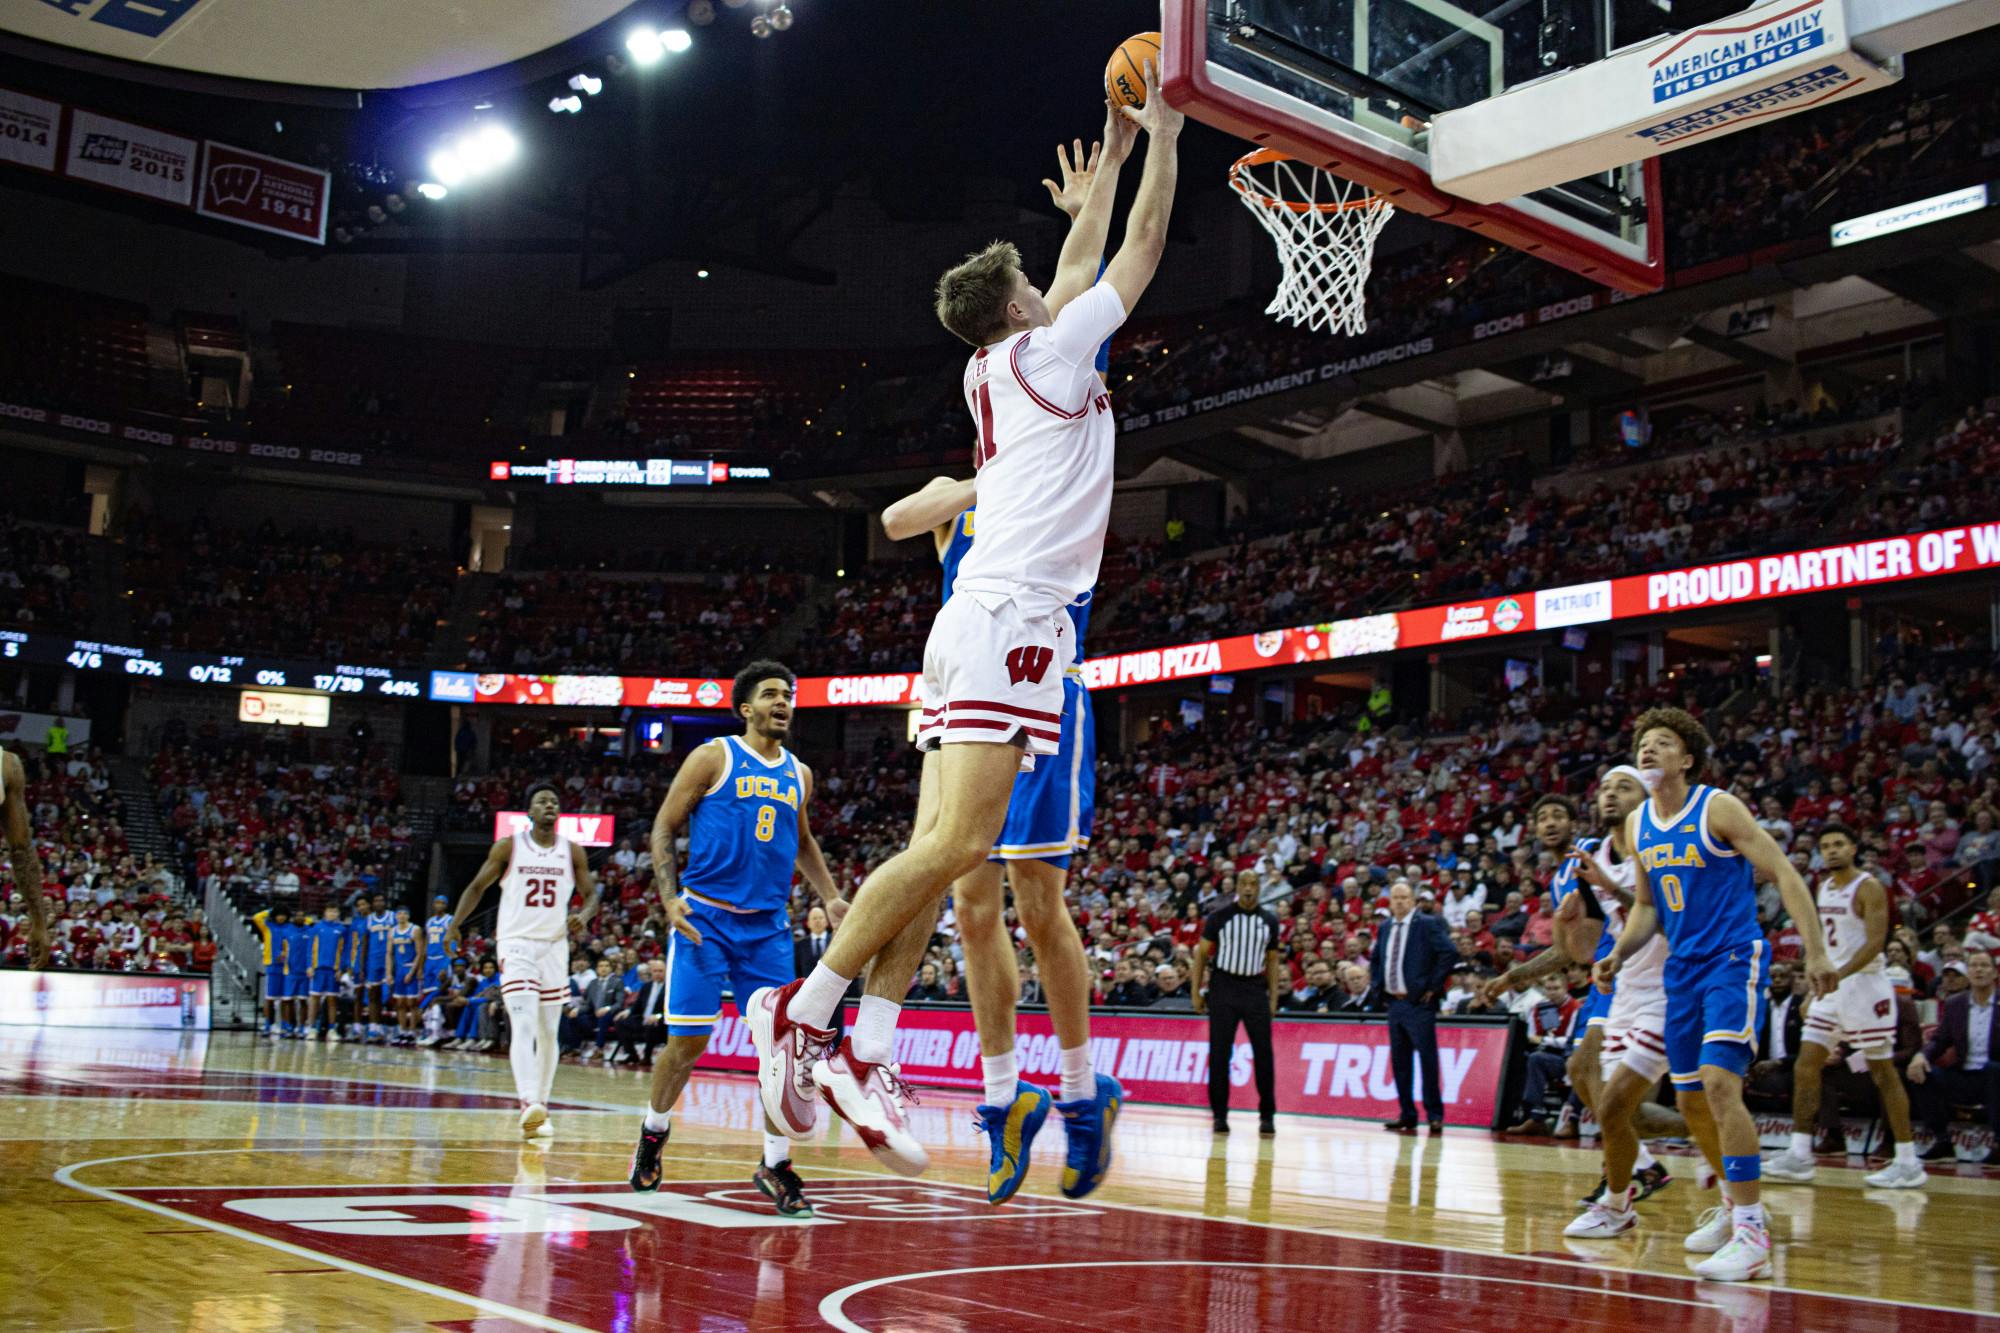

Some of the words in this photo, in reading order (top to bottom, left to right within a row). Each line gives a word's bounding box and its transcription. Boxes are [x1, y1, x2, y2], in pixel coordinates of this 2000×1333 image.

[1653, 39, 1747, 86] AMERICAN
[1753, 10, 1822, 52] FAMILY
[1663, 38, 1812, 98] INSURANCE
[1116, 74, 1146, 110] CAA
[130, 159, 185, 182] 2015
[260, 197, 315, 223] 1941
[1473, 314, 1526, 341] 2004
[1122, 414, 1150, 432] BIG
[1156, 404, 1188, 424] TEN
[1193, 372, 1316, 412] TOURNAMENT
[1320, 338, 1434, 380] CHAMPIONS
[60, 411, 112, 435] 2003
[188, 436, 237, 454] 2015
[249, 443, 302, 460] 2020
[310, 448, 362, 465] 2022
[510, 465, 548, 476] TOYOTA
[672, 465, 705, 476] FINAL
[729, 467, 770, 478] TOYOTA
[1647, 563, 1753, 611] PROUD
[1758, 538, 1912, 596] PARTNER
[1917, 530, 1966, 572] OF
[5, 642, 18, 658] 5
[75, 639, 101, 652] FREE
[67, 651, 103, 669] 4/6
[125, 658, 163, 676] 67%
[190, 665, 232, 683] 0/12
[256, 669, 286, 686] 0%
[1005, 645, 1054, 687] W
[1120, 651, 1161, 684] PUB
[1162, 642, 1222, 678] PIZZA
[379, 679, 420, 696] 44%
[828, 675, 908, 704] CHOMP
[735, 775, 799, 811] UCLA
[754, 804, 777, 843] 8
[525, 878, 557, 908] 25
[1660, 873, 1685, 912] 0
[1826, 918, 1839, 947] 2
